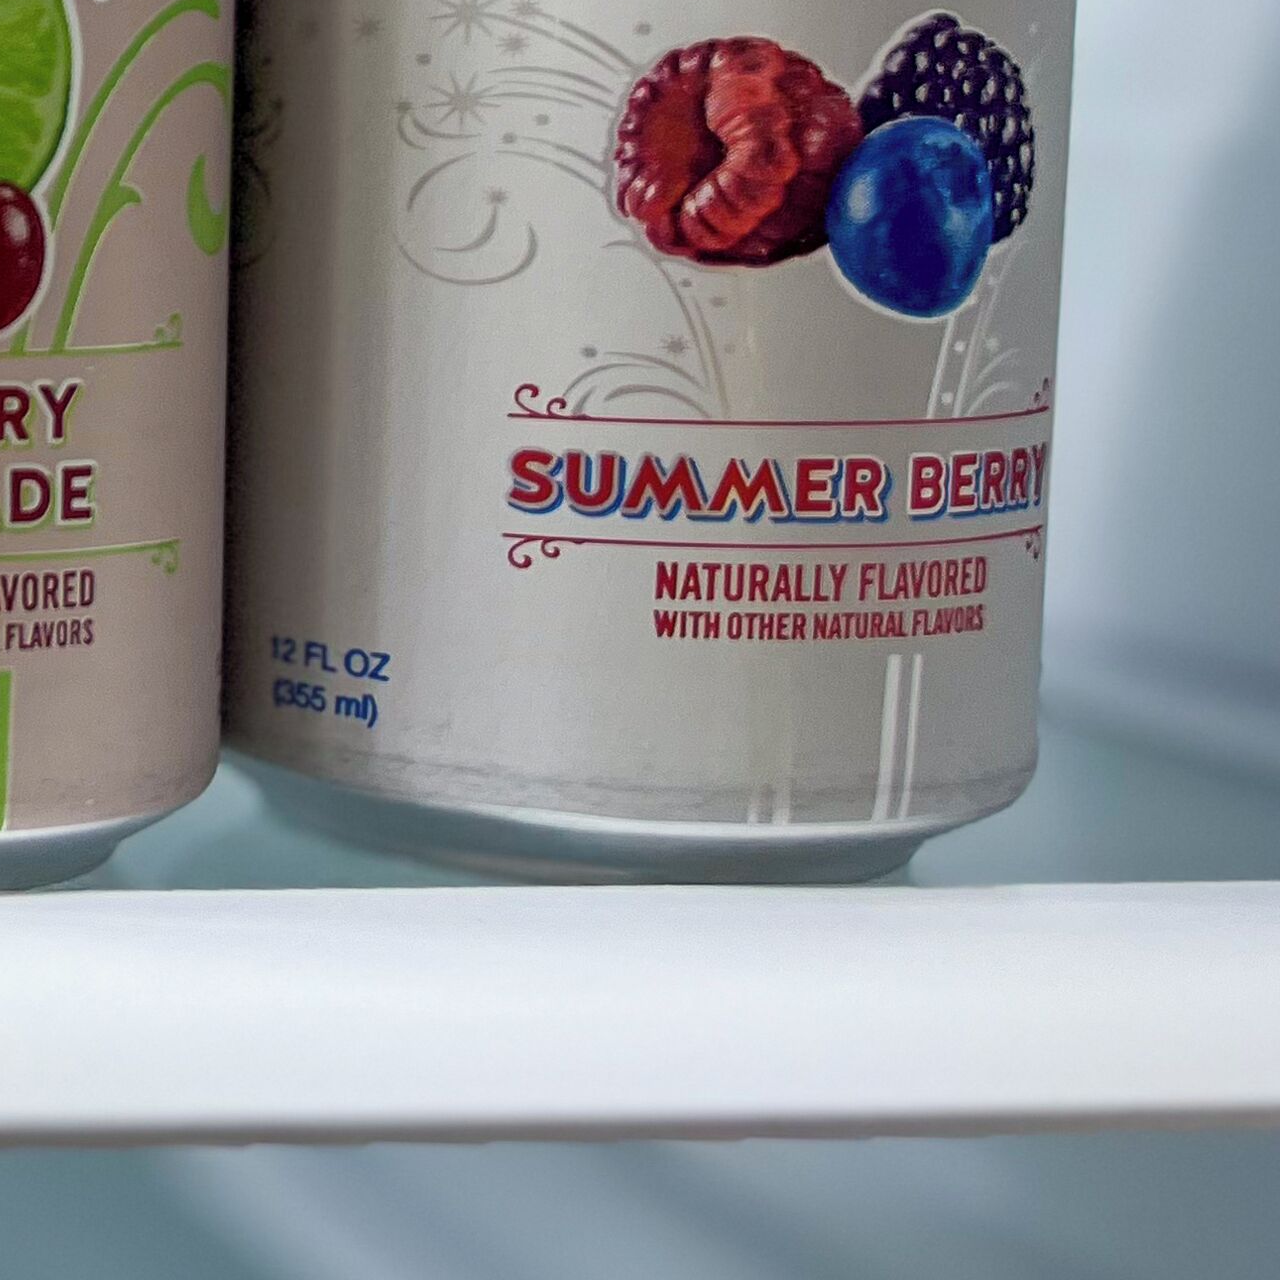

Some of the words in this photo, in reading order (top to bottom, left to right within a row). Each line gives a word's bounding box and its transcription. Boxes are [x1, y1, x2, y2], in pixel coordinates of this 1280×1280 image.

[507, 447, 892, 523] SUMMER
[907, 441, 1047, 521] BERRY
[654, 560, 848, 603] NATURALLY
[858, 555, 988, 602] FLAVORED
[5, 617, 95, 651] FLAVORS
[653, 608, 720, 639] WITH
[727, 611, 807, 641] OTHER
[812, 611, 909, 640] NATURAL
[912, 603, 985, 638] FLAVORS
[272, 634, 296, 665] 12
[303, 640, 338, 673] FL
[343, 647, 390, 682] OZ
[334, 693, 379, 729] ml)
